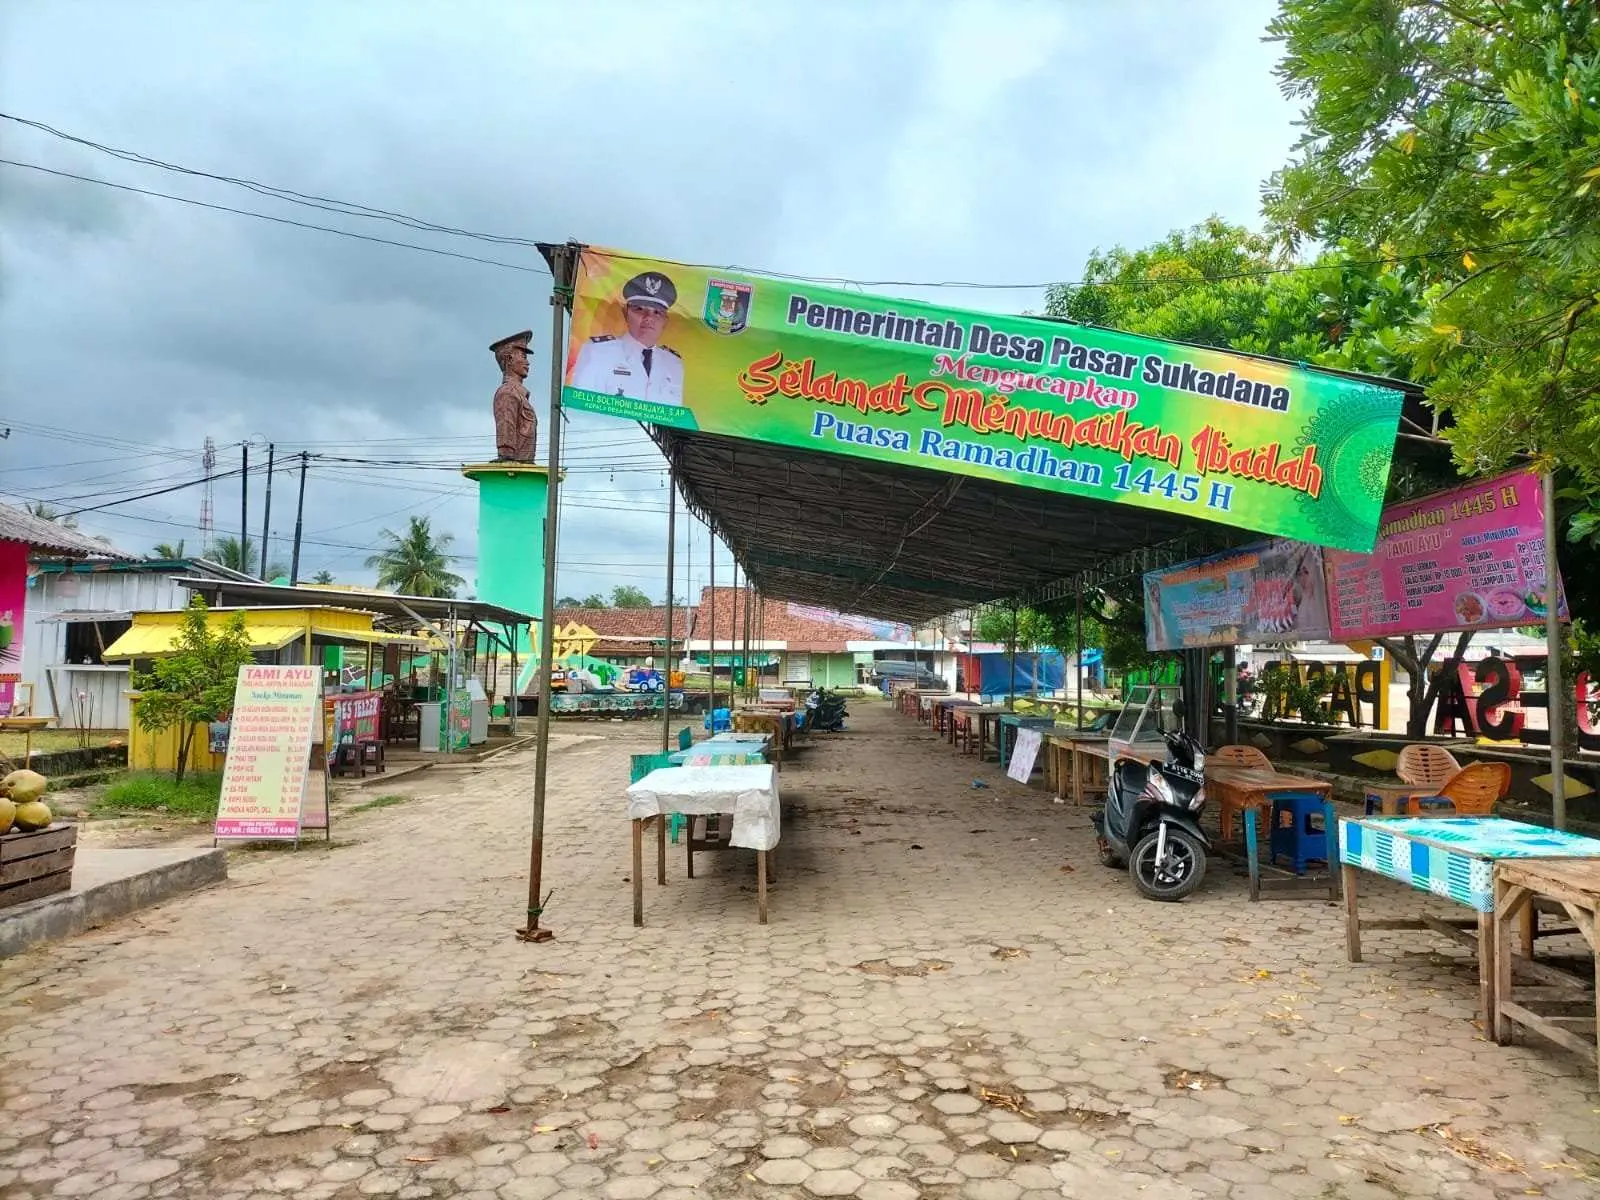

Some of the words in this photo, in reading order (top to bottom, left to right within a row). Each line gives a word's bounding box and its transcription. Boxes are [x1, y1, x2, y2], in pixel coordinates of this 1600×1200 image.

[786, 294, 964, 353] Pemerintah
[969, 323, 1044, 363] Desa
[1050, 337, 1139, 379] Pasar
[1142, 355, 1291, 412] Sukadana
[930, 352, 1139, 410] Mengucapkan
[572, 390, 595, 402] DELLY
[737, 351, 913, 415] Selamat
[912, 379, 1182, 470] Menunaikan
[1190, 424, 1323, 498] Ibadah
[811, 411, 910, 452] Puasa
[920, 428, 1102, 485] Ramadhan
[1112, 462, 1200, 503] 1445
[1207, 481, 1236, 511] H
[1380, 508, 1447, 541] amadhan
[1451, 491, 1497, 522] 1445
[1500, 485, 1520, 508] H
[1417, 532, 1442, 552] AYU
[246, 668, 280, 679] TAMI
[285, 668, 312, 679] AYU
